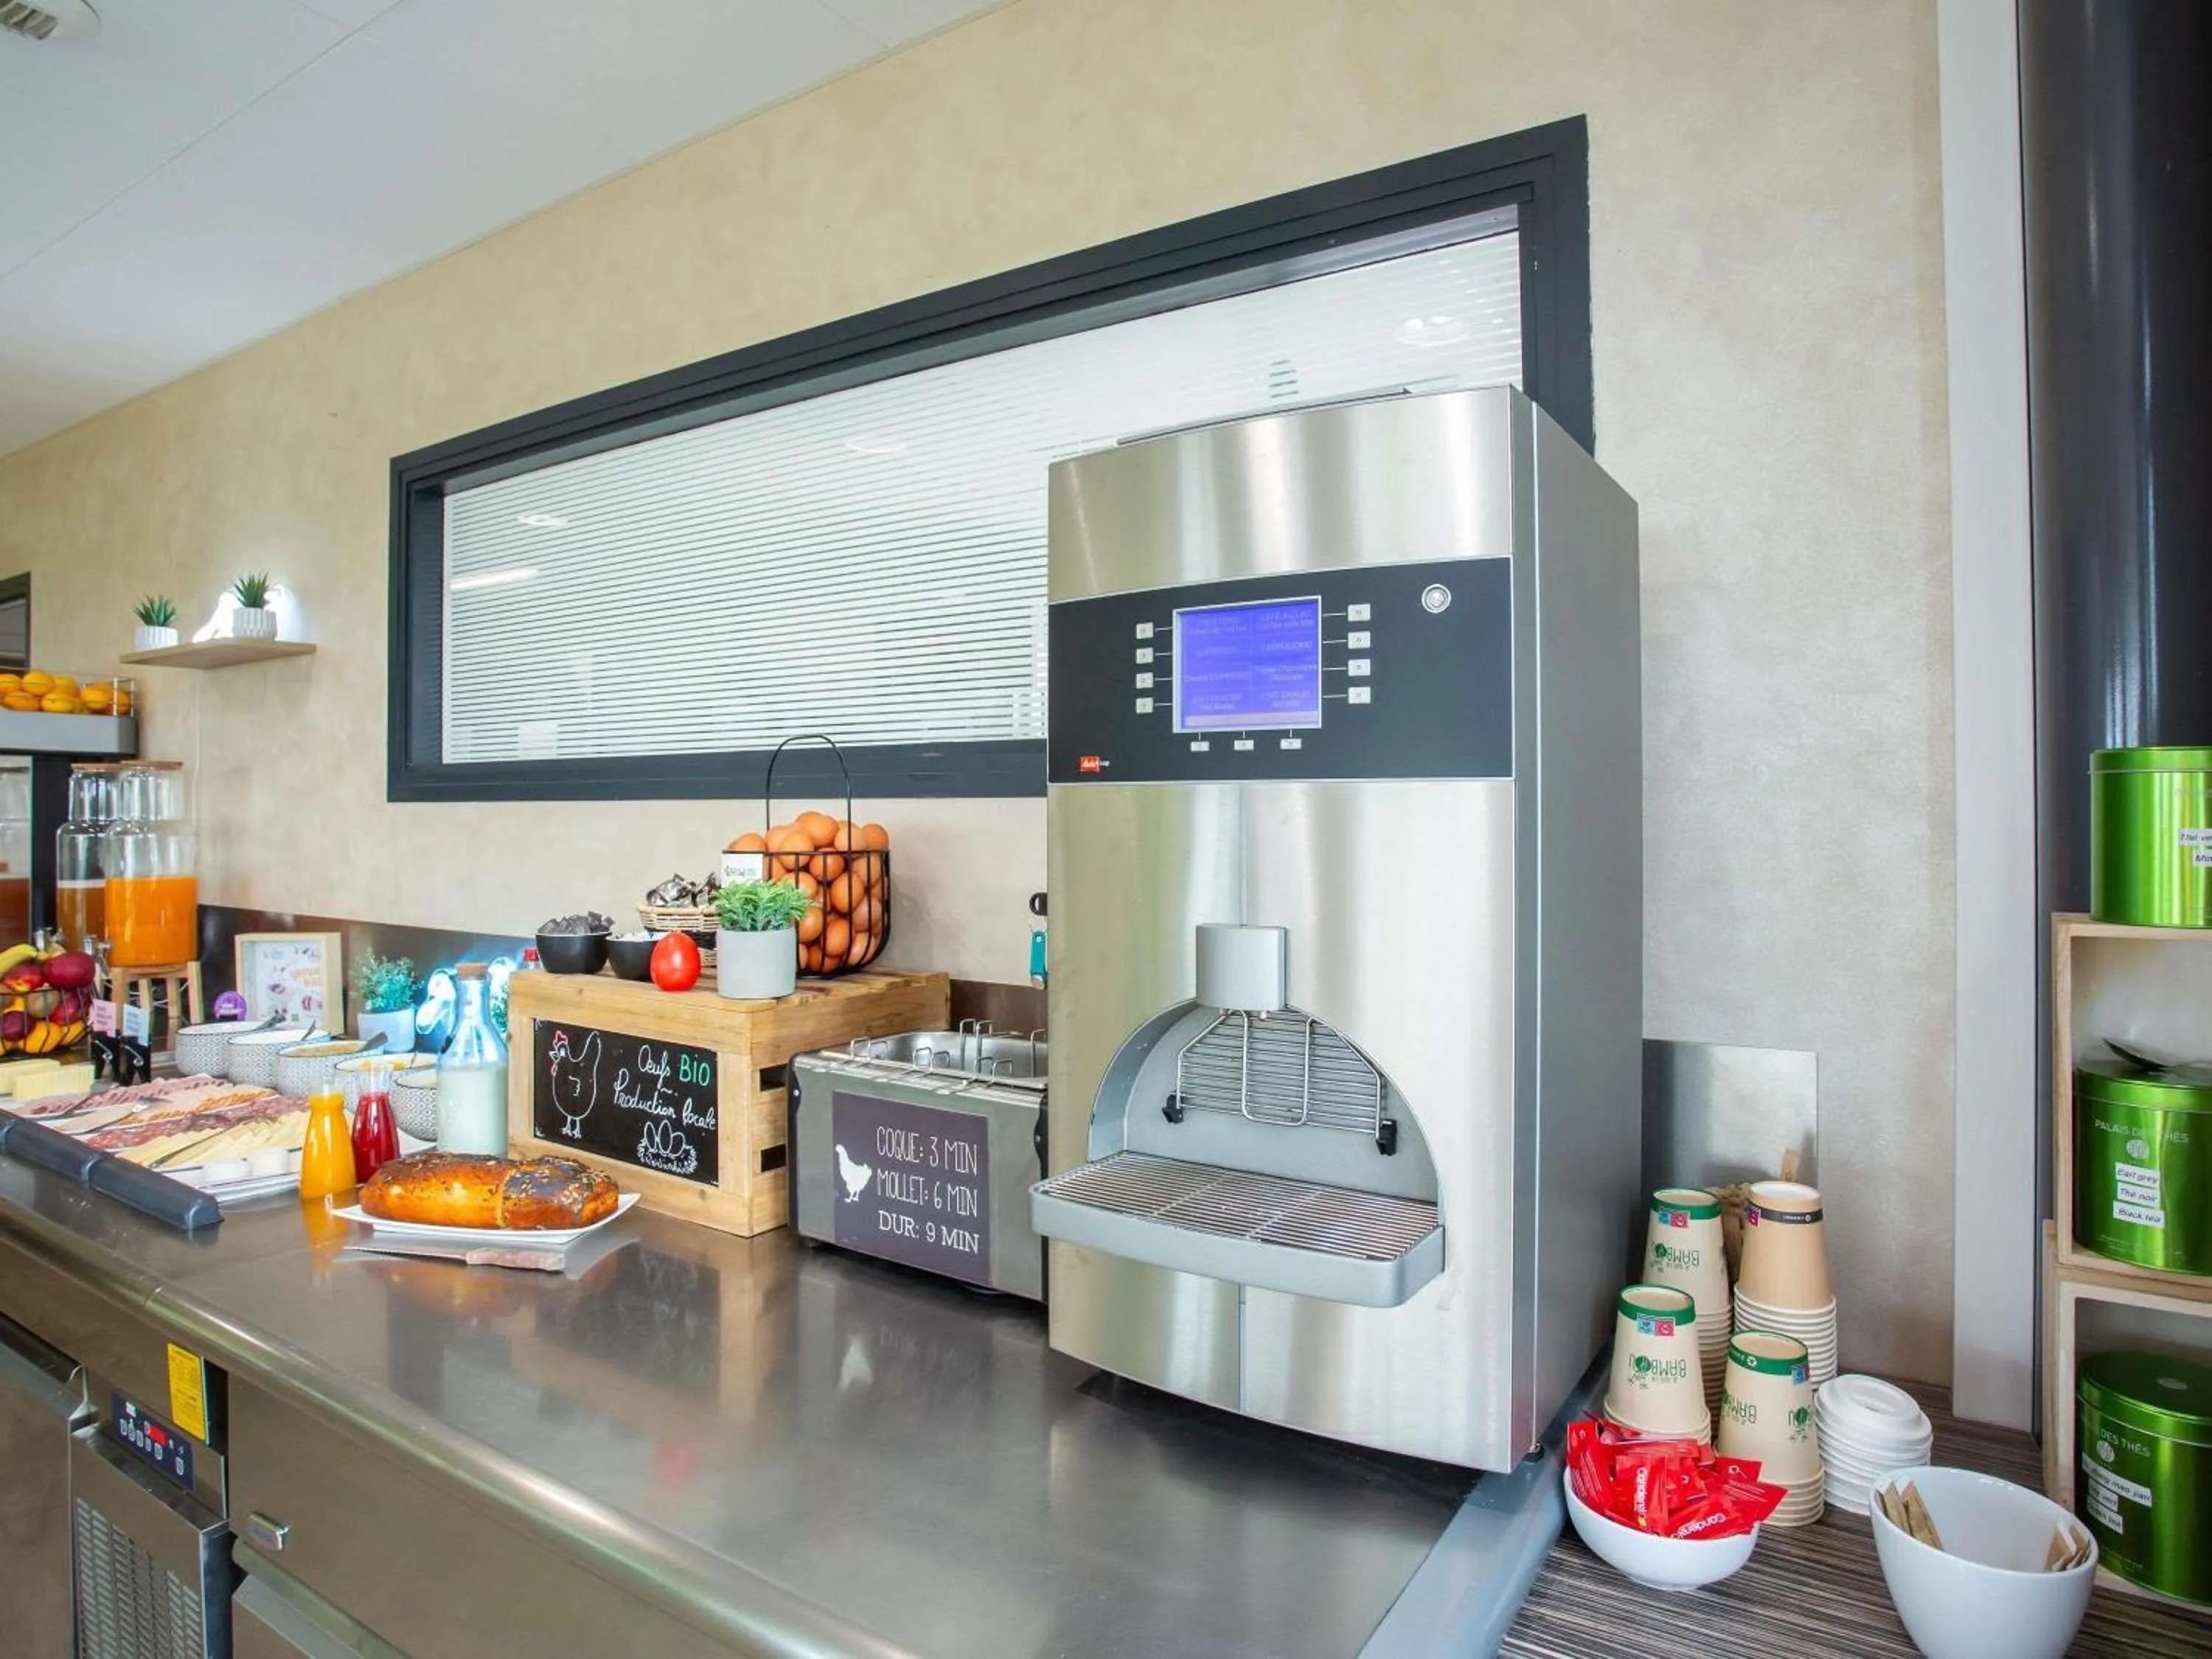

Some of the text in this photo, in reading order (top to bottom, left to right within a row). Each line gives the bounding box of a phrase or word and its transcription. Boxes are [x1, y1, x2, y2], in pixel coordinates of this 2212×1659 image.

[613, 1068, 676, 1119] Production
[876, 1126, 978, 1177] COQUE: 3 MIN
[876, 1167, 978, 1218] MOLLET: 6 MIN
[878, 1210, 980, 1254] DUR: 9 MIN
[1629, 1353, 1687, 1378] BAMBOU
